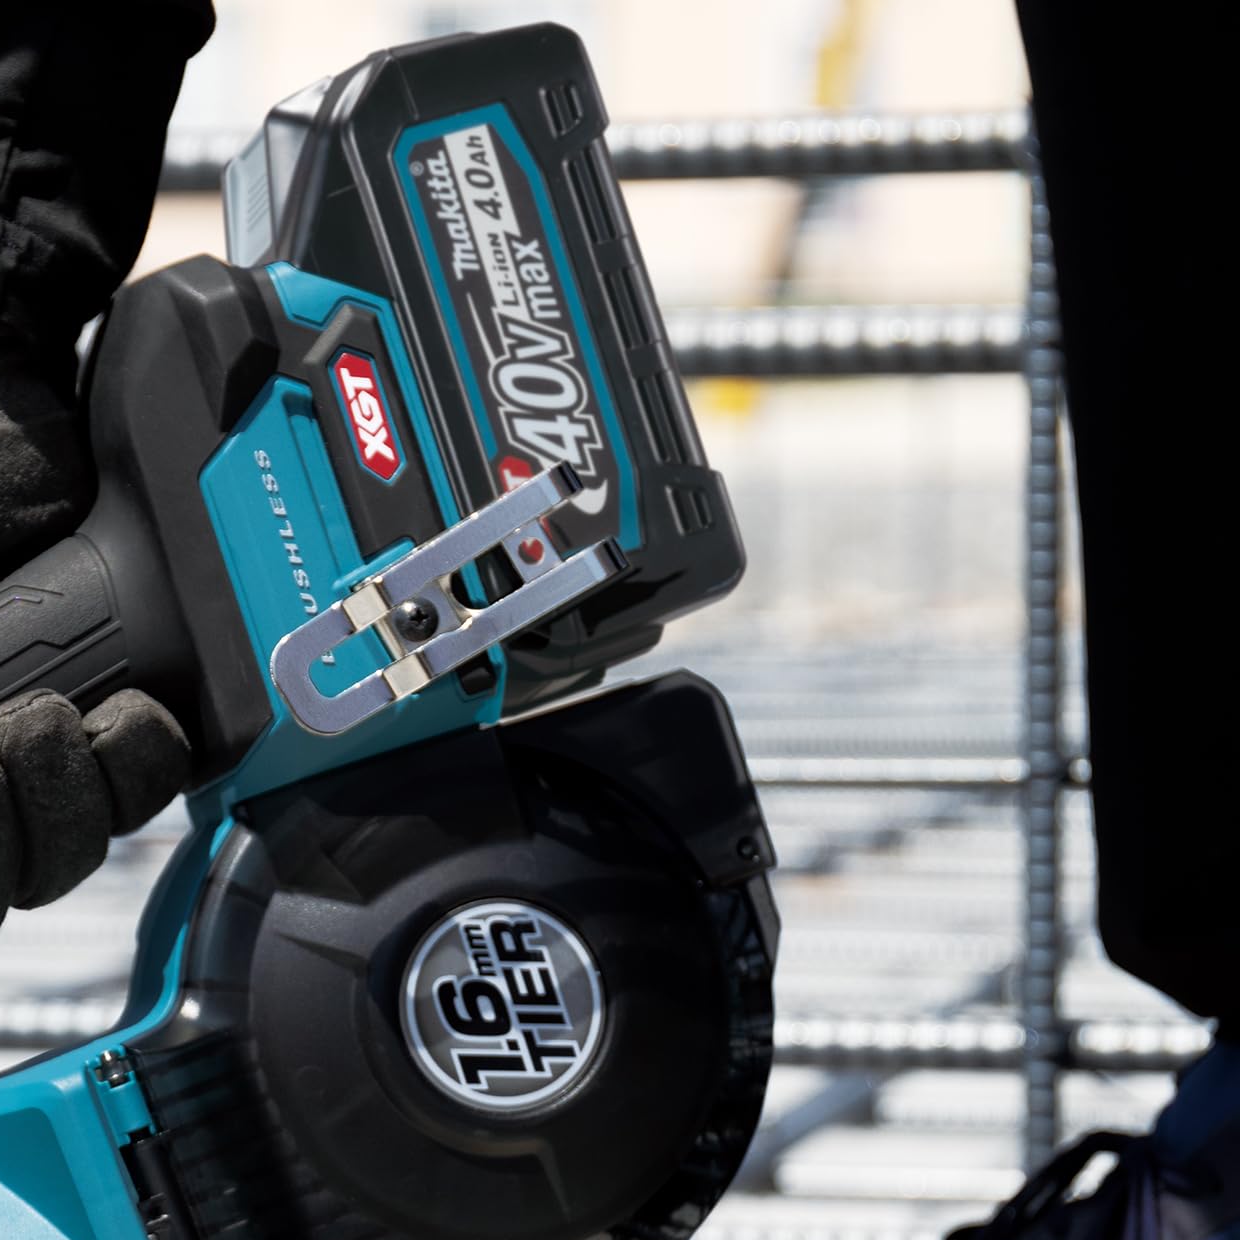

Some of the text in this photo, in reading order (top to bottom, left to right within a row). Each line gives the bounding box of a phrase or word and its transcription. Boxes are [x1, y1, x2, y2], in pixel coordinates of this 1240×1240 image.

[464, 135, 503, 220] 4.0Ah
[339, 367, 395, 461] XGT
[488, 919, 579, 1074] TIER
